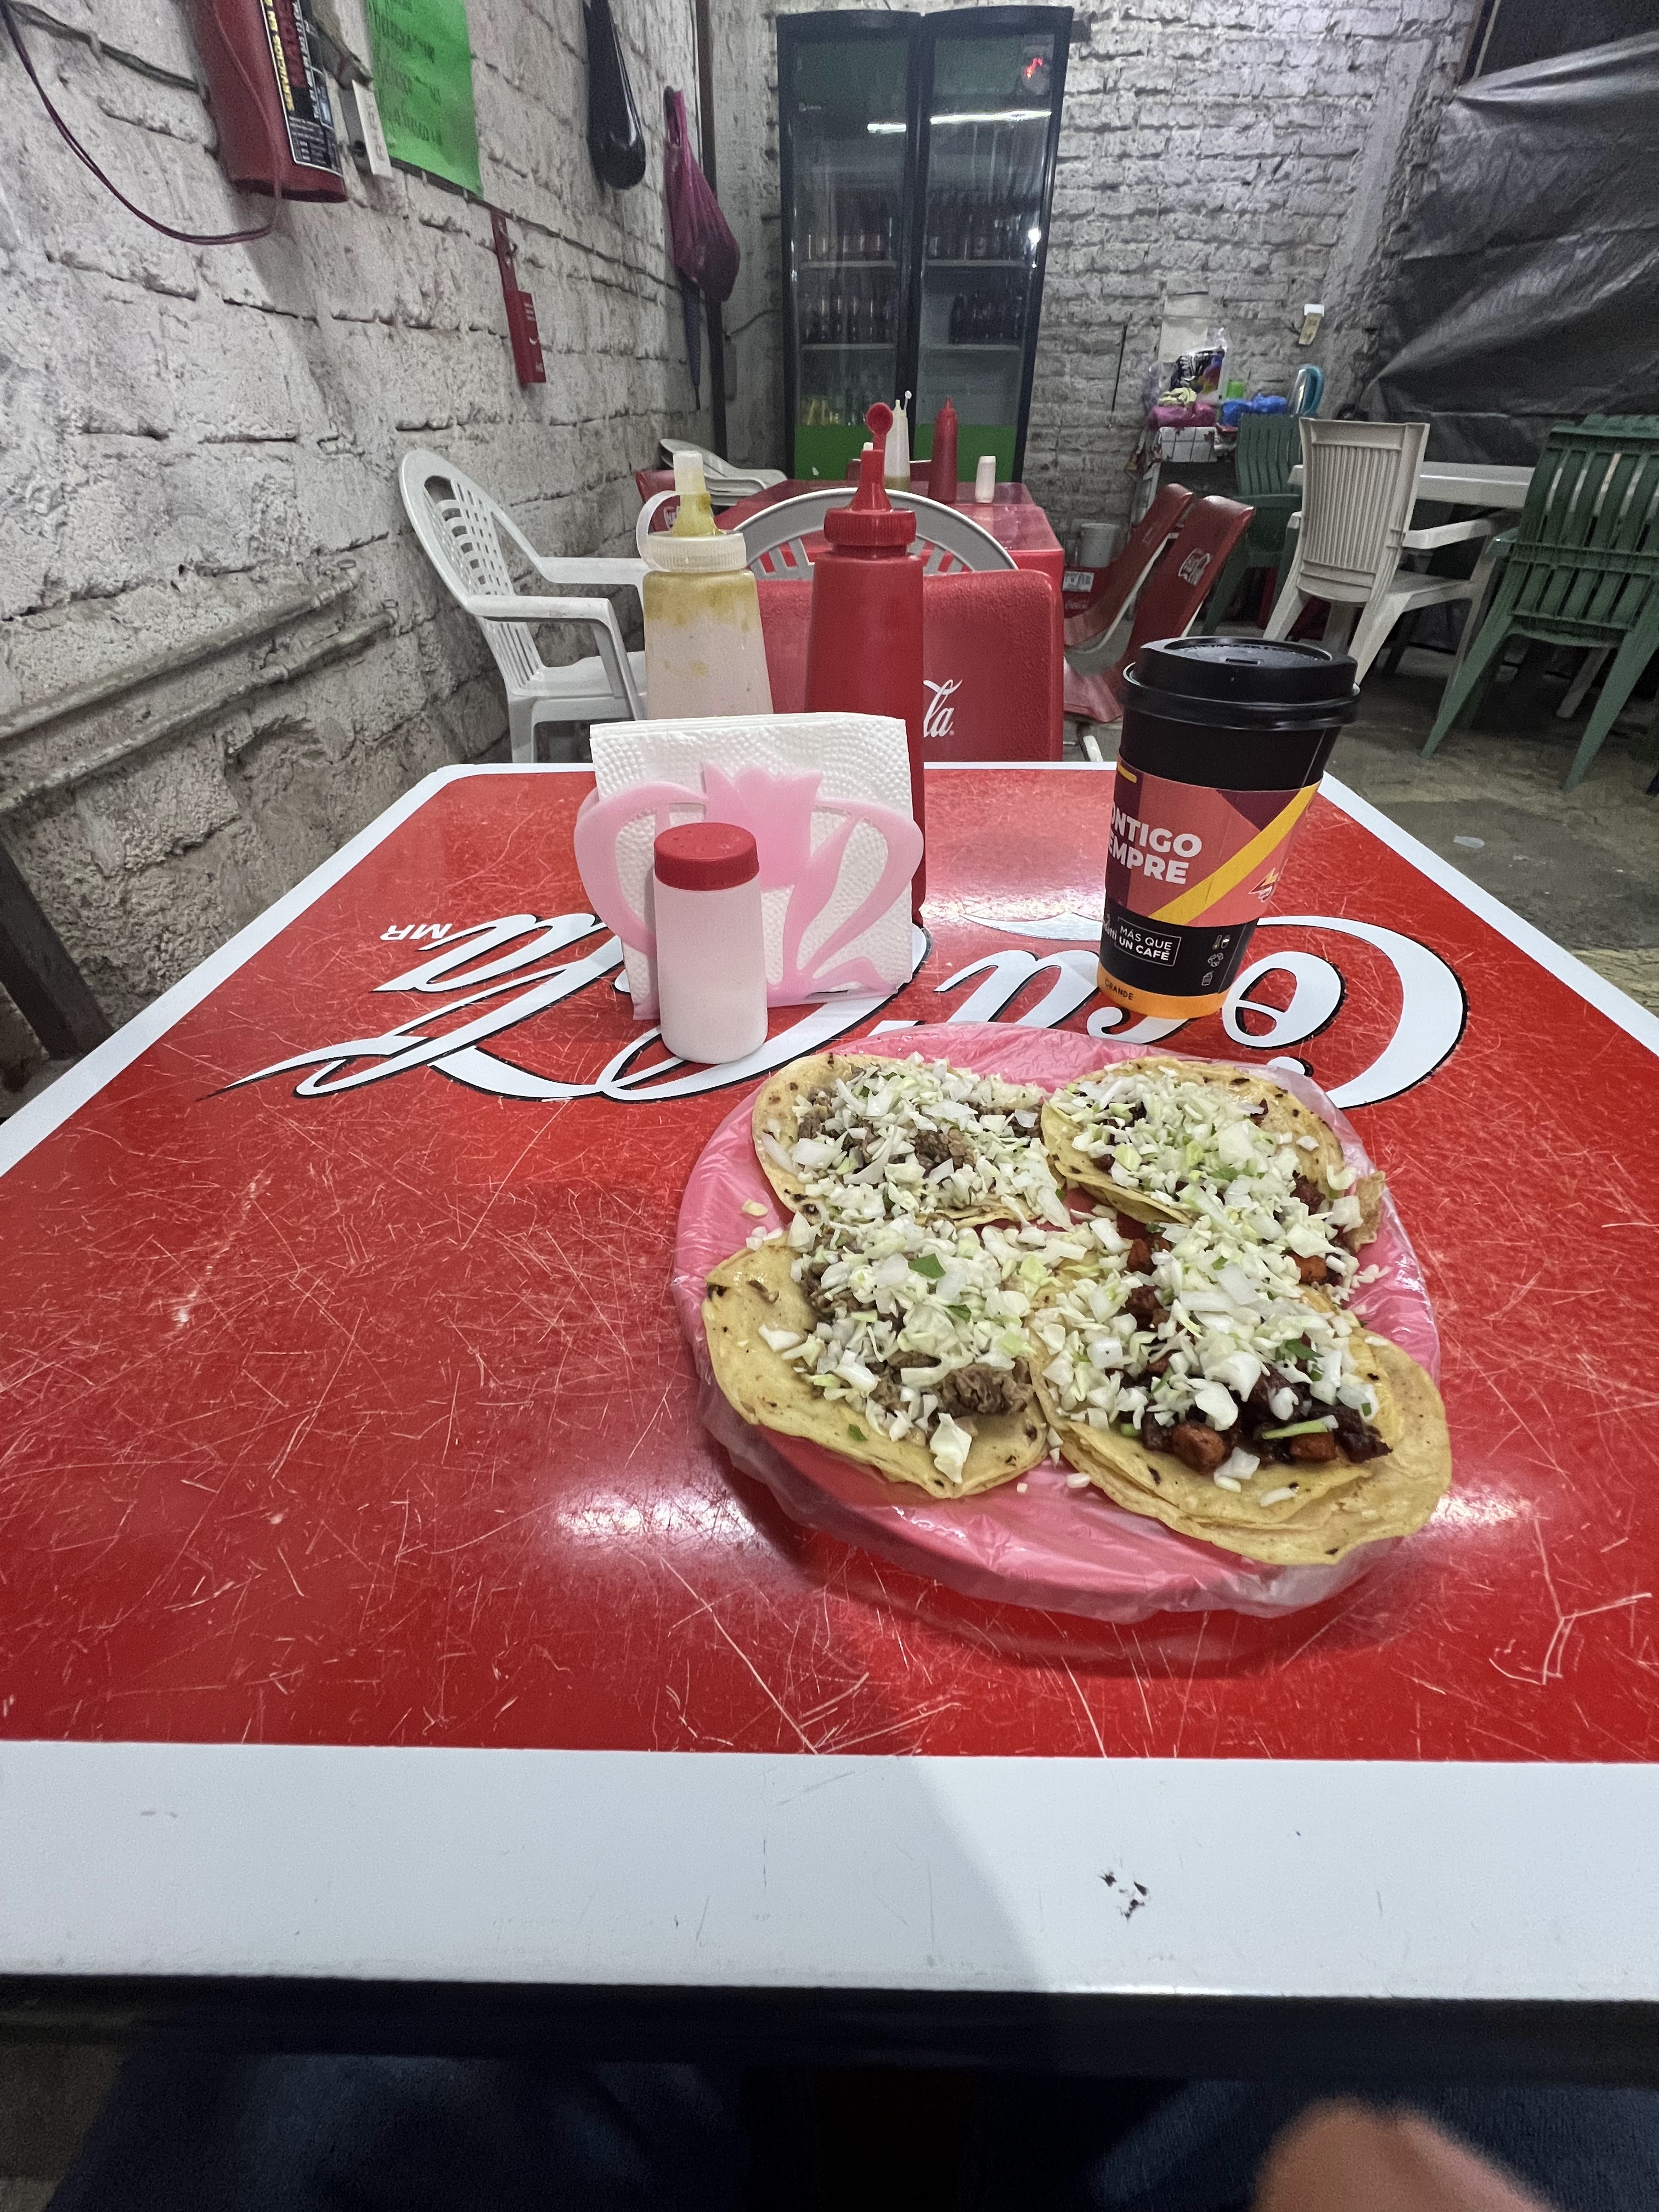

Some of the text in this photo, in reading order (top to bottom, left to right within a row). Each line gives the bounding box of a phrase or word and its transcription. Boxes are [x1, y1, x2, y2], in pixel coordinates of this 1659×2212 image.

[273, 35, 295, 111] SERVICIOS
[1111, 801, 1202, 857] NTIGO
[1108, 828, 1189, 884] EMPRE
[380, 923, 453, 941] MR
[1120, 926, 1173, 951] MÁS QUE
[1119, 936, 1170, 961] UN CAFÉ
[1104, 979, 1134, 1001] GRANDE
